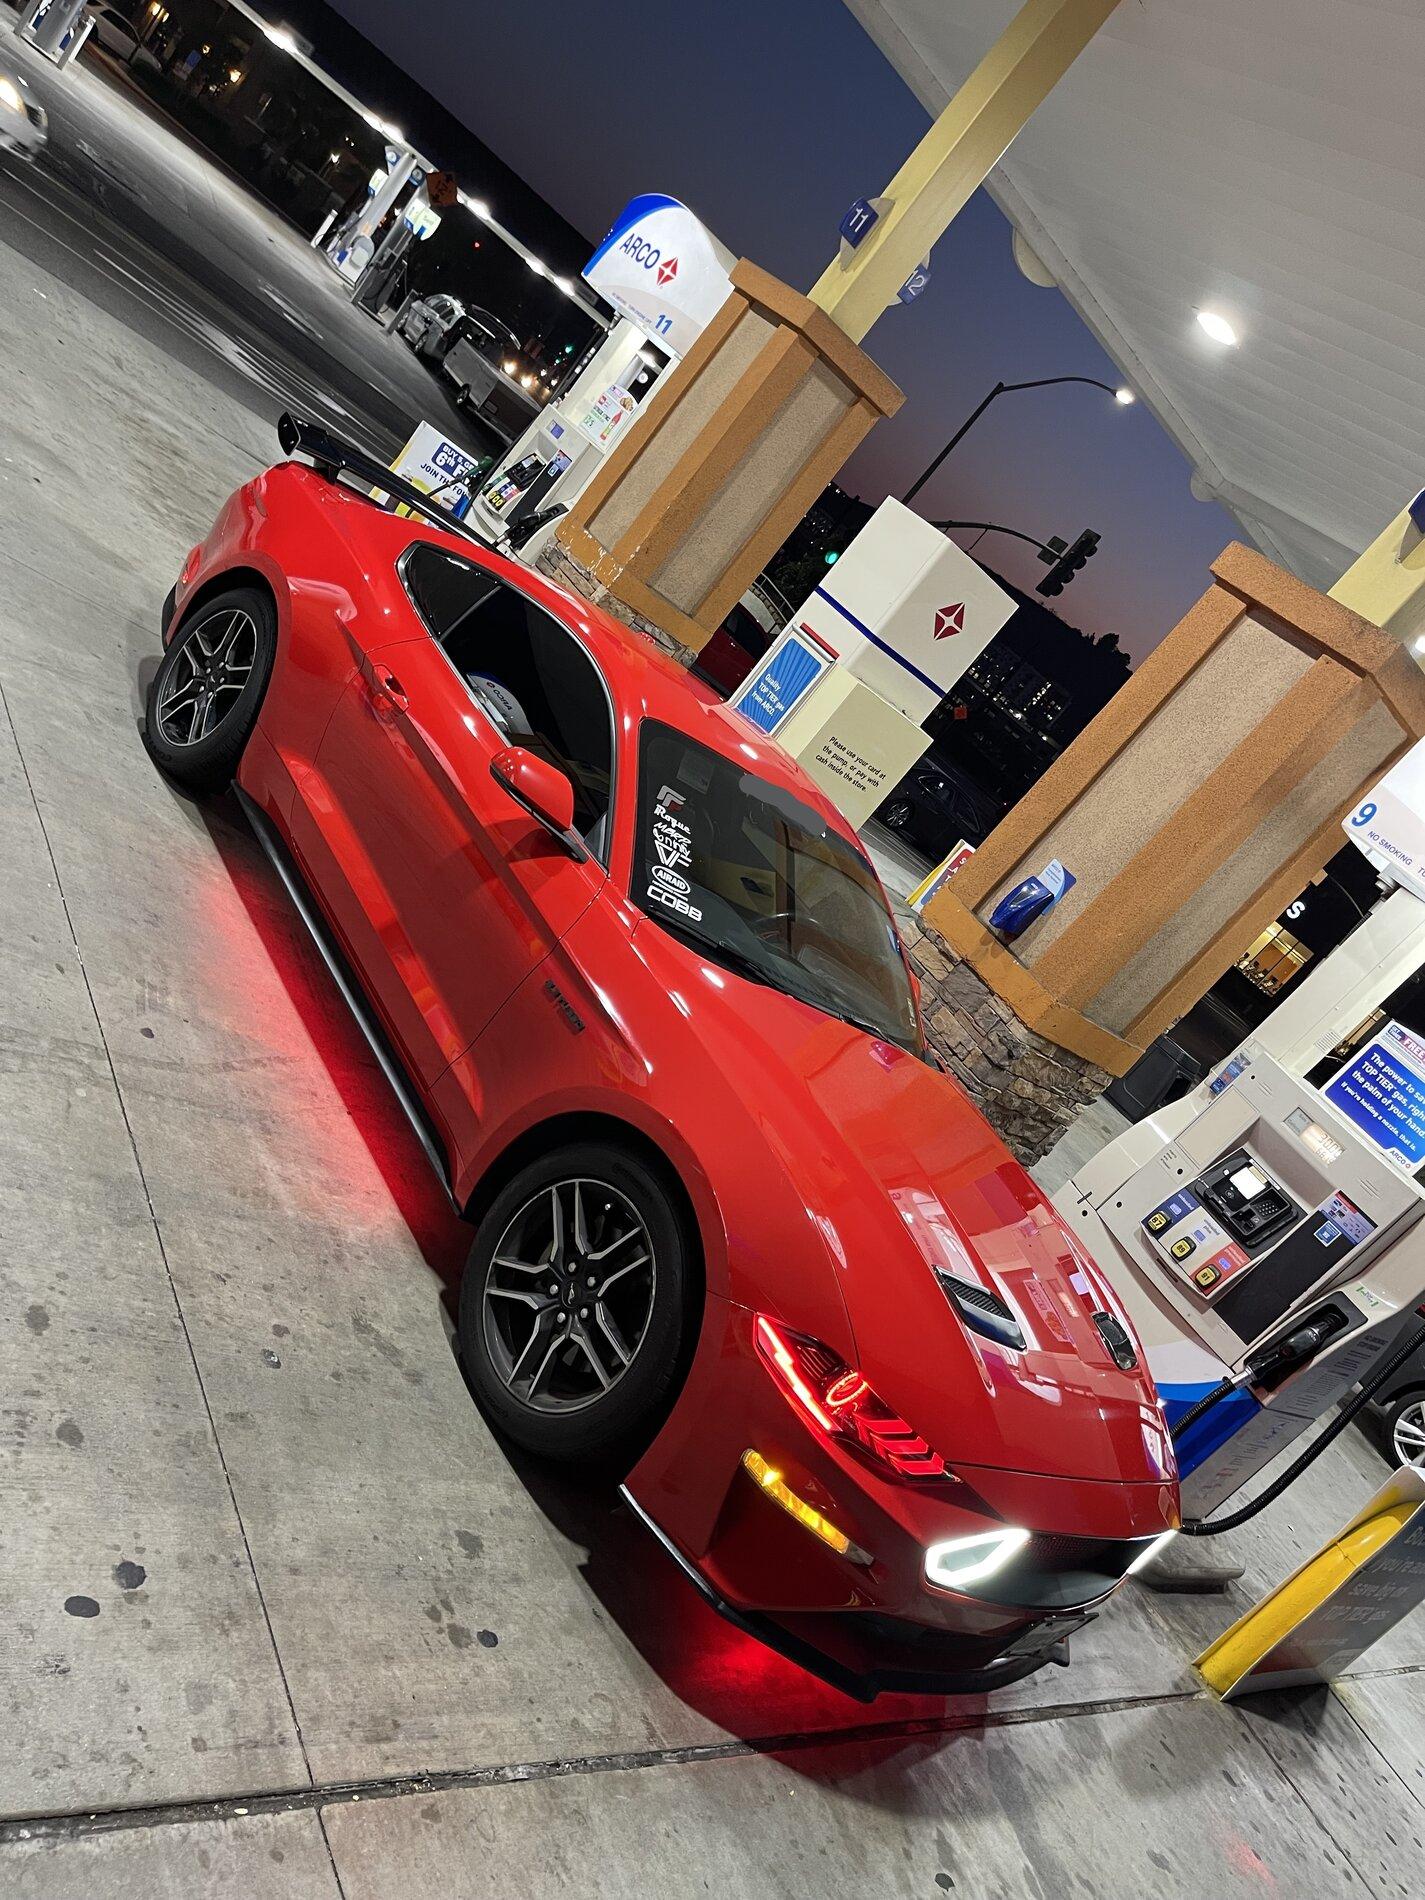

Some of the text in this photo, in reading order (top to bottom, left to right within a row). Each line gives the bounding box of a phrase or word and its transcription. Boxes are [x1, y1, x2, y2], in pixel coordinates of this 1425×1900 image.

[850, 208, 868, 232] 11
[620, 233, 661, 269] ARCO
[905, 270, 925, 296] 12
[655, 314, 672, 334] 11
[435, 452, 456, 467] 6th
[442, 445, 458, 459] BUY
[464, 461, 475, 469] GE
[420, 463, 439, 478] JOIN
[439, 474, 452, 488] TH
[765, 674, 781, 692] Quality
[752, 691, 762, 704] from
[758, 682, 785, 712] TOP TIER gas
[822, 745, 832, 755] the
[831, 753, 848, 767] pump,
[855, 770, 867, 780] pay
[867, 777, 879, 787] with
[829, 736, 847, 752] Please
[846, 750, 856, 758] use
[854, 757, 868, 767] your
[868, 765, 881, 776] card
[816, 754, 867, 792] cash inside the store.
[1351, 803, 1377, 826] 9
[1367, 831, 1380, 841] NO
[1379, 840, 1413, 866] SMOKING
[656, 870, 685, 891] AIRAID
[647, 885, 702, 922] COBB
[1403, 1036, 1424, 1059] FREE
[1362, 1061, 1378, 1077] TOP
[1391, 1090, 1408, 1107] gas,
[1371, 1052, 1384, 1068] The
[1383, 1065, 1408, 1086] power
[1406, 1082, 1415, 1094] to
[1352, 1070, 1365, 1084] the
[1362, 1081, 1382, 1100] palm
[1381, 1095, 1391, 1108] of
[1387, 1102, 1408, 1121] your
[1344, 1085, 1361, 1101] you're
[1359, 1098, 1379, 1118] holding
[1381, 1117, 1400, 1138] nozzle,
[1399, 1134, 1410, 1146] that
[1390, 1150, 1406, 1165] ARCO
[1151, 1217, 1162, 1227] 87
[1176, 1244, 1185, 1253] 89
